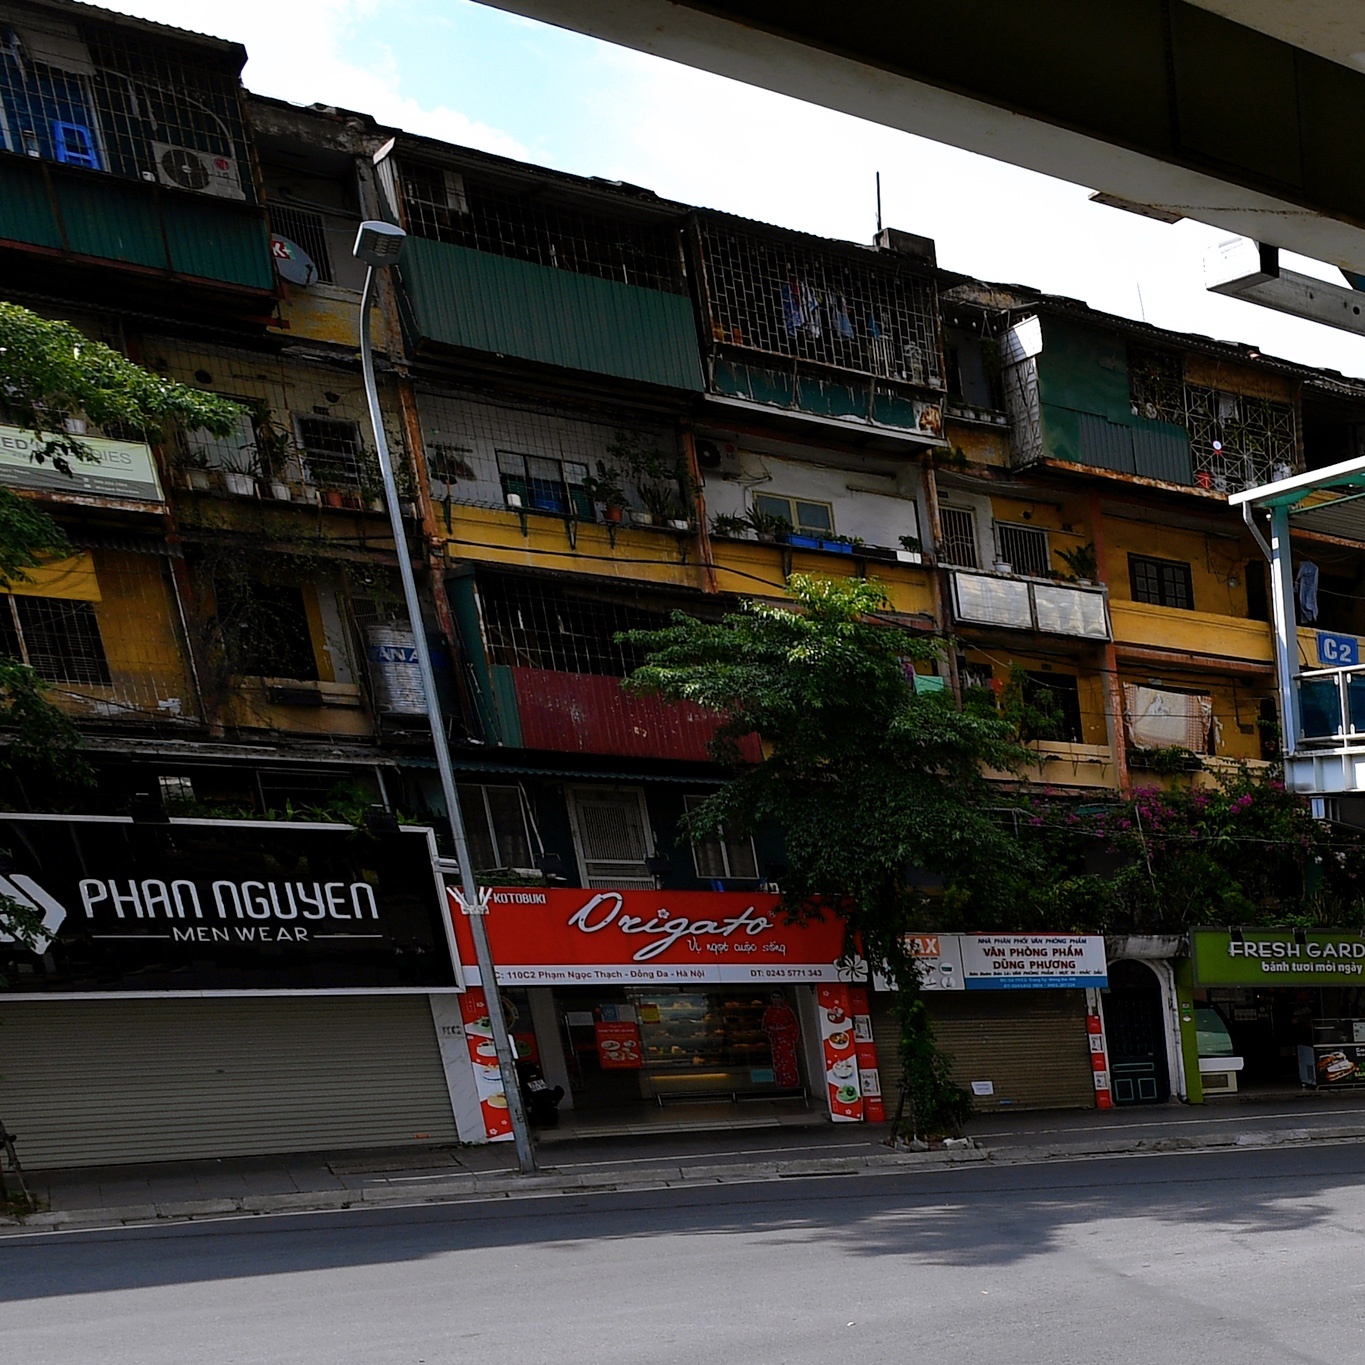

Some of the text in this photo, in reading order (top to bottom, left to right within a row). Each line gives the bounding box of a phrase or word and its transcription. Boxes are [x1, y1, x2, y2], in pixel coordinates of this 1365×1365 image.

[1323, 637, 1352, 663] C2
[78, 878, 380, 919] PHAN NGUYEN
[172, 926, 310, 942] MEN WEAR
[567, 891, 774, 962] Origato
[983, 946, 1006, 957] VĂN
[1010, 945, 1048, 957] PHÒNG
[1228, 941, 1301, 958] FRESH
[993, 958, 1076, 969] DŨNG PHƯƠNG
[1261, 961, 1289, 972] bánh
[1337, 961, 1363, 975] ngày
[507, 971, 536, 979] 110C2
[538, 970, 565, 981] Phạm
[568, 970, 592, 981] Ngọc
[595, 970, 623, 980] Thạch
[676, 969, 688, 978] Hà
[691, 969, 705, 979] Nội
